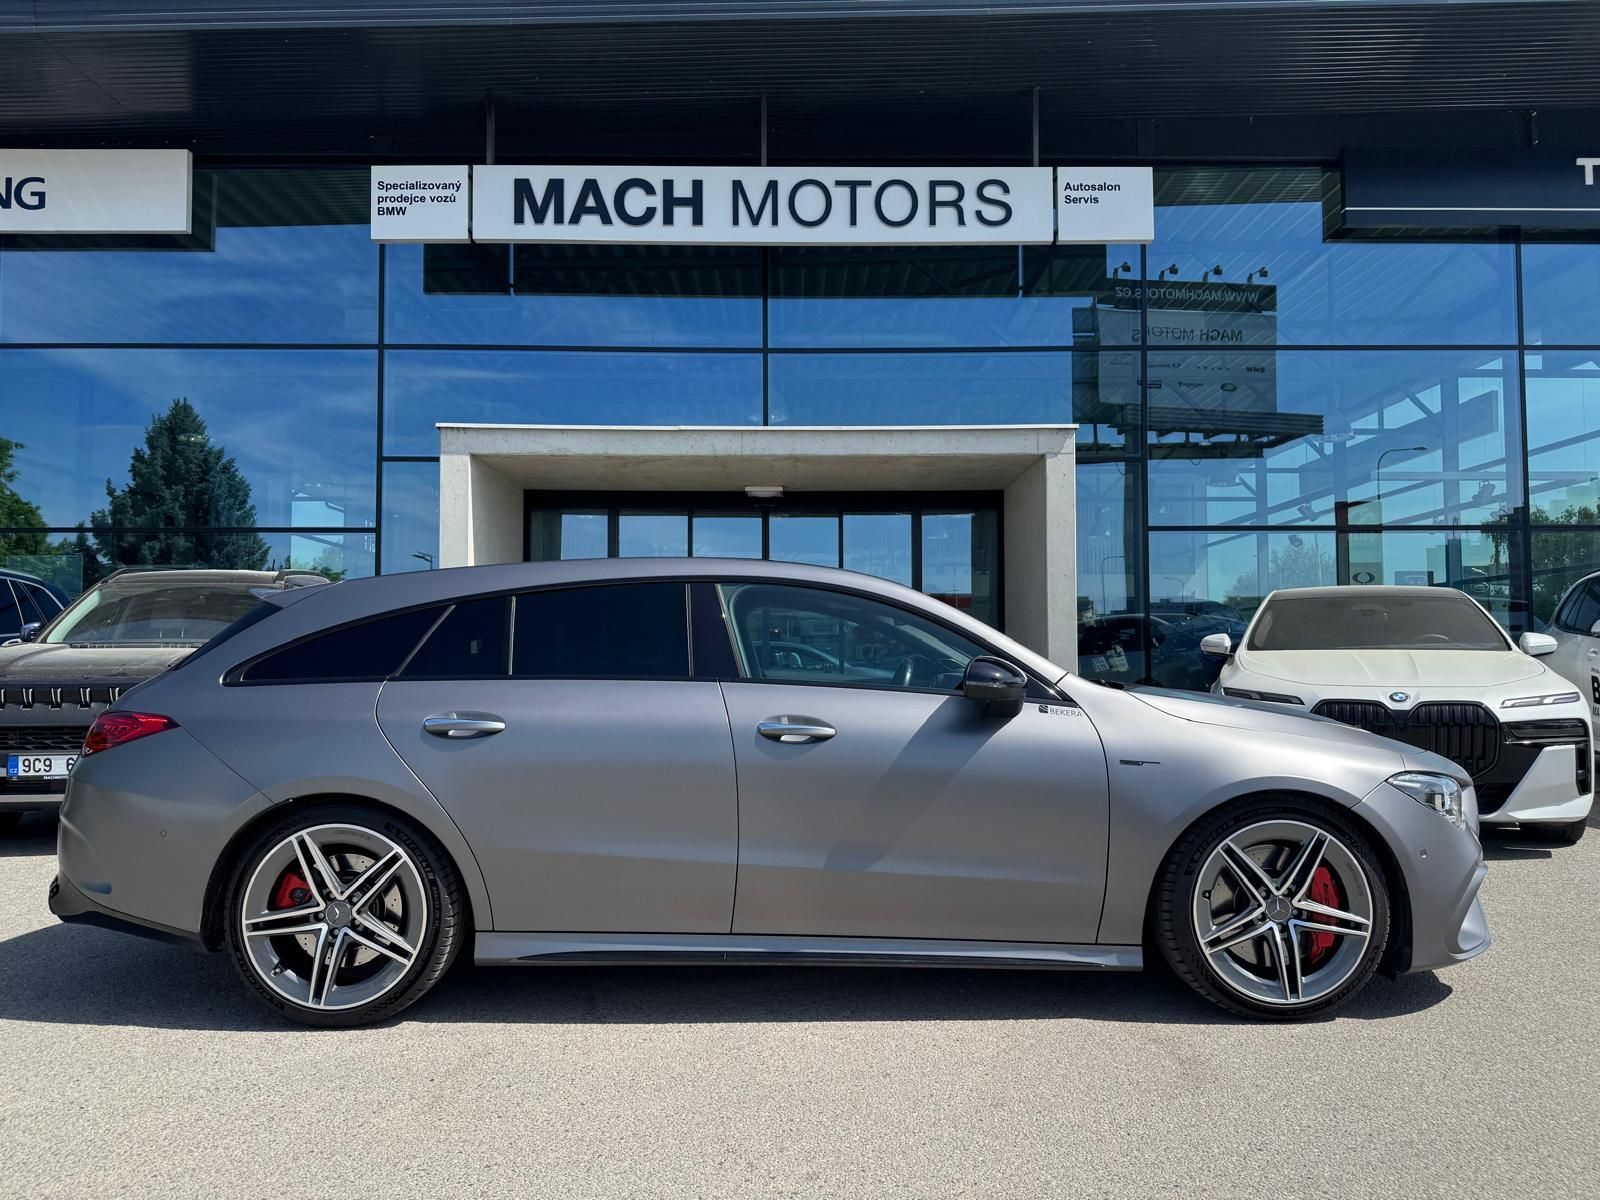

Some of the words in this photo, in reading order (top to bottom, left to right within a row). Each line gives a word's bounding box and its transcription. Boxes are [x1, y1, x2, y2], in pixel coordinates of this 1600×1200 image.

[1576, 158, 1600, 185] T
[378, 181, 461, 193] Specializovaný
[1064, 182, 1121, 192] Autosalon
[378, 194, 426, 205] prodejce
[430, 193, 456, 203] vozů
[514, 178, 703, 226] MACH
[732, 179, 1012, 227] MOTORS
[1064, 195, 1099, 205] Servis
[378, 207, 406, 216] BMW
[1049, 707, 1083, 717] BEKERA
[22, 758, 52, 773] 9C9
[397, 831, 436, 880] MICHELIN
